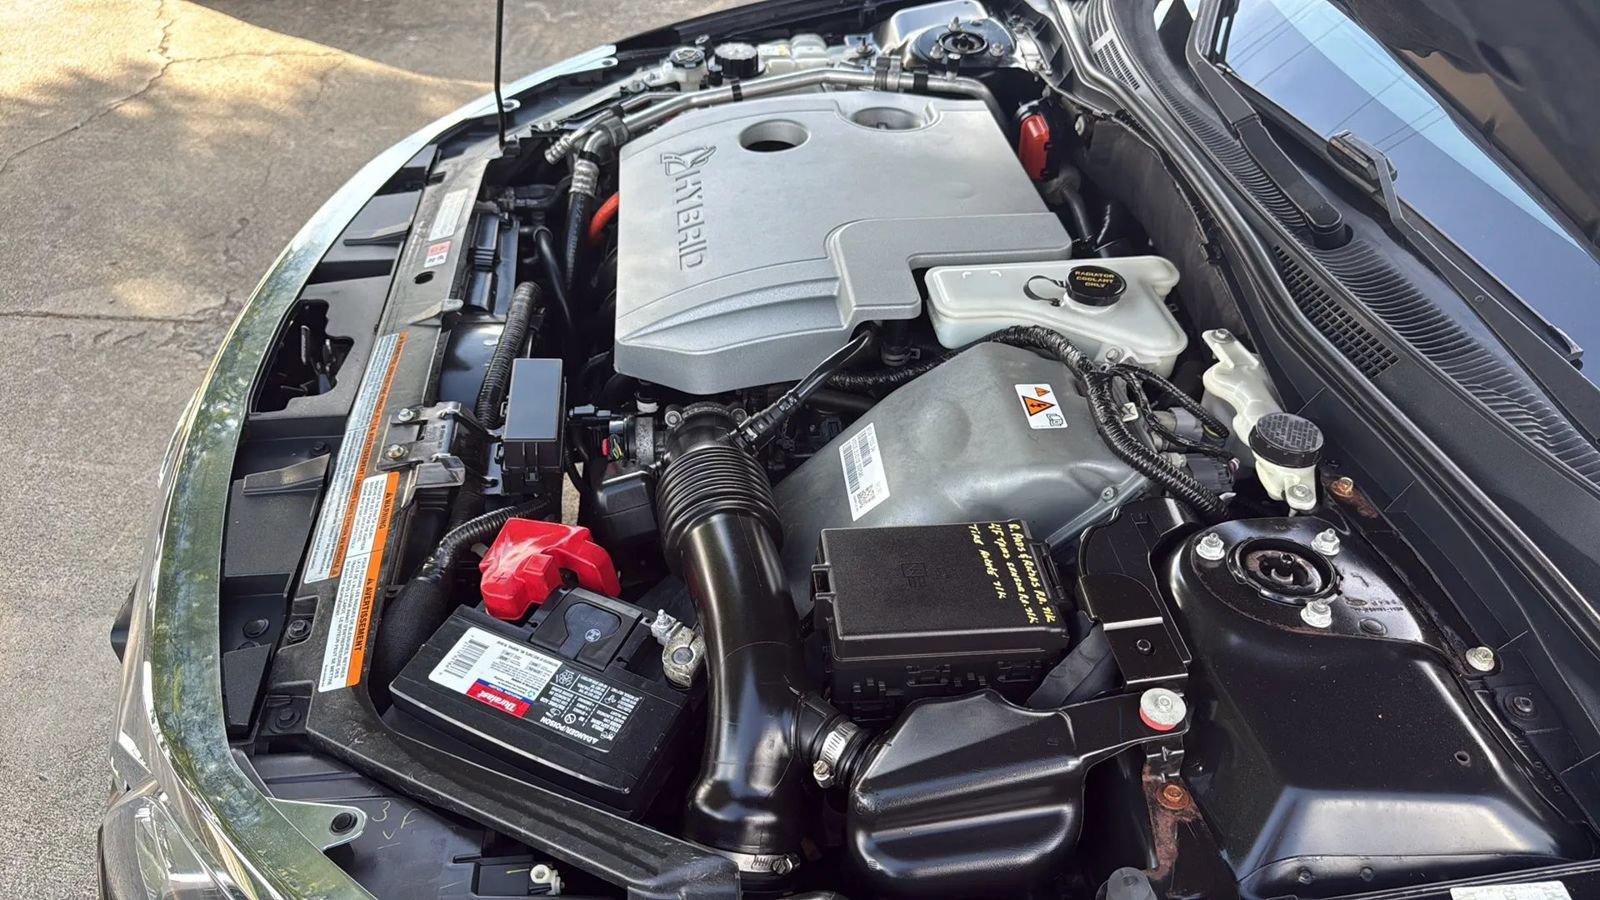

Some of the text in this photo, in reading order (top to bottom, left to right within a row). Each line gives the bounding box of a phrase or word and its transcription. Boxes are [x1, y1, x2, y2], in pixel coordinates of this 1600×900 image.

[674, 170, 707, 271] HYBRID
[1074, 270, 1114, 278] RADIATOR
[1076, 276, 1114, 284] COOLANT
[378, 498, 391, 528] WARNING
[1011, 533, 1026, 552] PADS
[352, 586, 374, 652] AVERTISSEMENT
[478, 690, 517, 712] Duralast
[540, 716, 594, 743] DANGER/POISON
